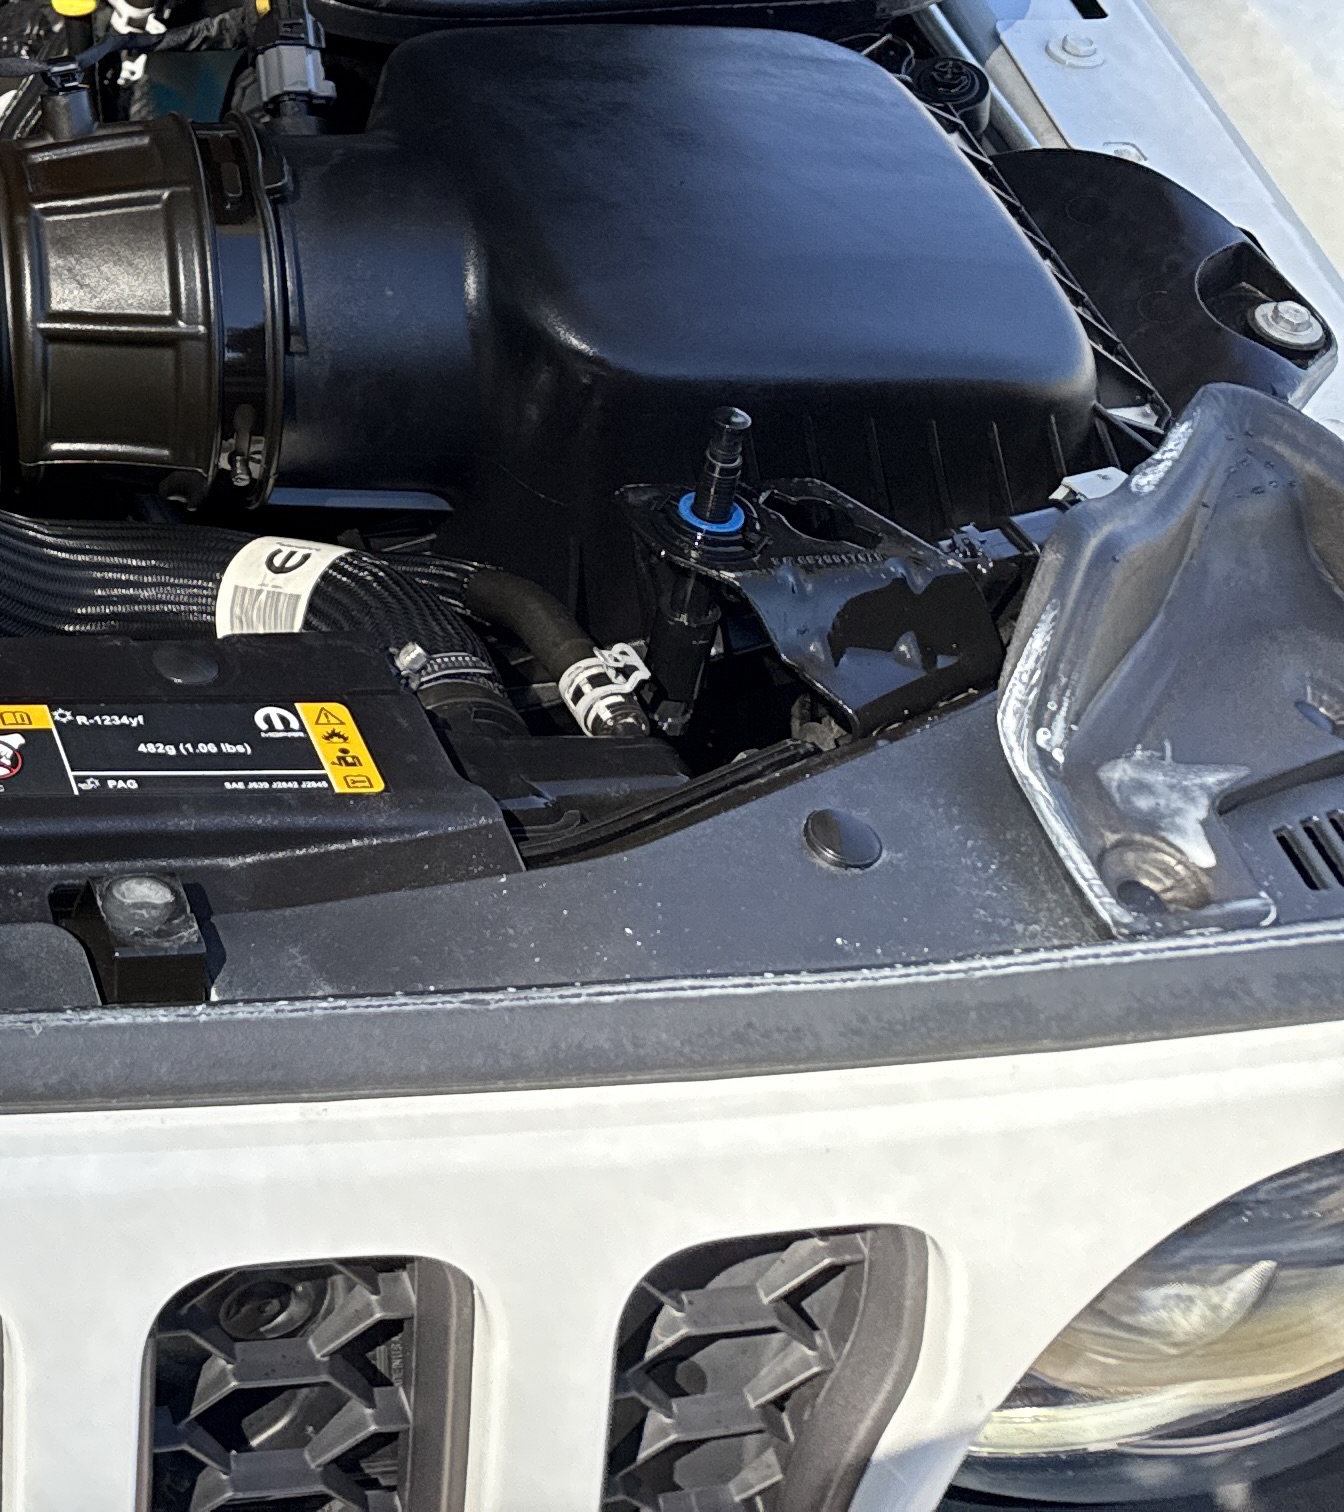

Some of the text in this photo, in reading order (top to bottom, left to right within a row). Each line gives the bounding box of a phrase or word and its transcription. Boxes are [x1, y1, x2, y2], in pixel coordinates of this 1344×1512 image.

[76, 714, 145, 727] R-1234yf
[137, 742, 252, 756] 482g (1.06 lbs)
[107, 779, 138, 789] PAG
